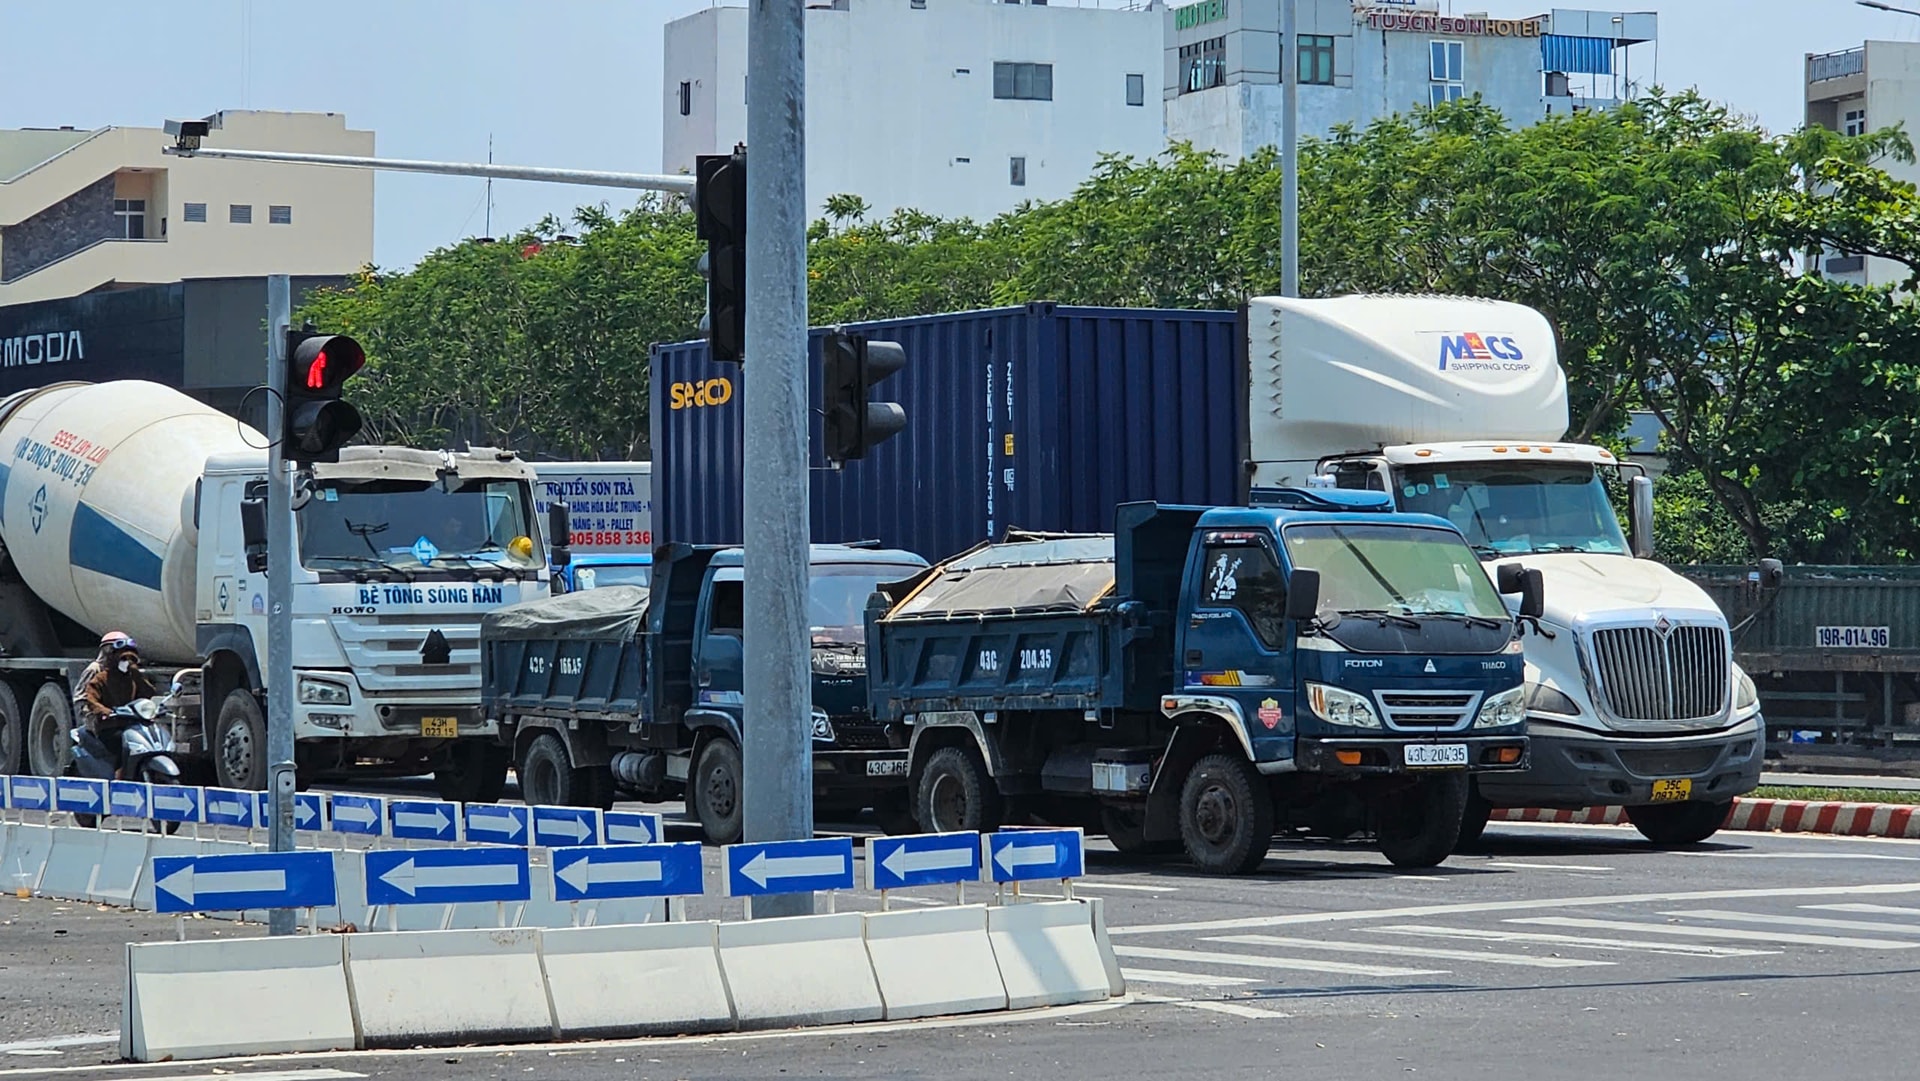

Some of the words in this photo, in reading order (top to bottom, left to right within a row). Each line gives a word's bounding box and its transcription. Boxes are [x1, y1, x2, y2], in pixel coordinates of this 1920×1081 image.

[1175, 0, 1228, 30] HOTEL
[1485, 20, 1540, 37] HOTEL
[0, 330, 83, 367] MODA
[1451, 363, 1500, 371] SHIPPING
[1503, 363, 1530, 371] CORP
[670, 377, 732, 409] seaco
[614, 478, 635, 496] TRÀ
[611, 519, 634, 530] PALLET
[569, 532, 593, 546] 905
[596, 532, 621, 546] 858
[626, 531, 650, 545] 336
[384, 585, 423, 604] TÔNG
[428, 585, 468, 604] SÔNG
[332, 606, 377, 614] HOWO
[1819, 628, 1888, 646] 19R-014.96
[980, 650, 997, 670] 43C
[1020, 648, 1052, 669] 204.35
[1345, 659, 1383, 668] FOTON
[1480, 661, 1506, 670] THACO
